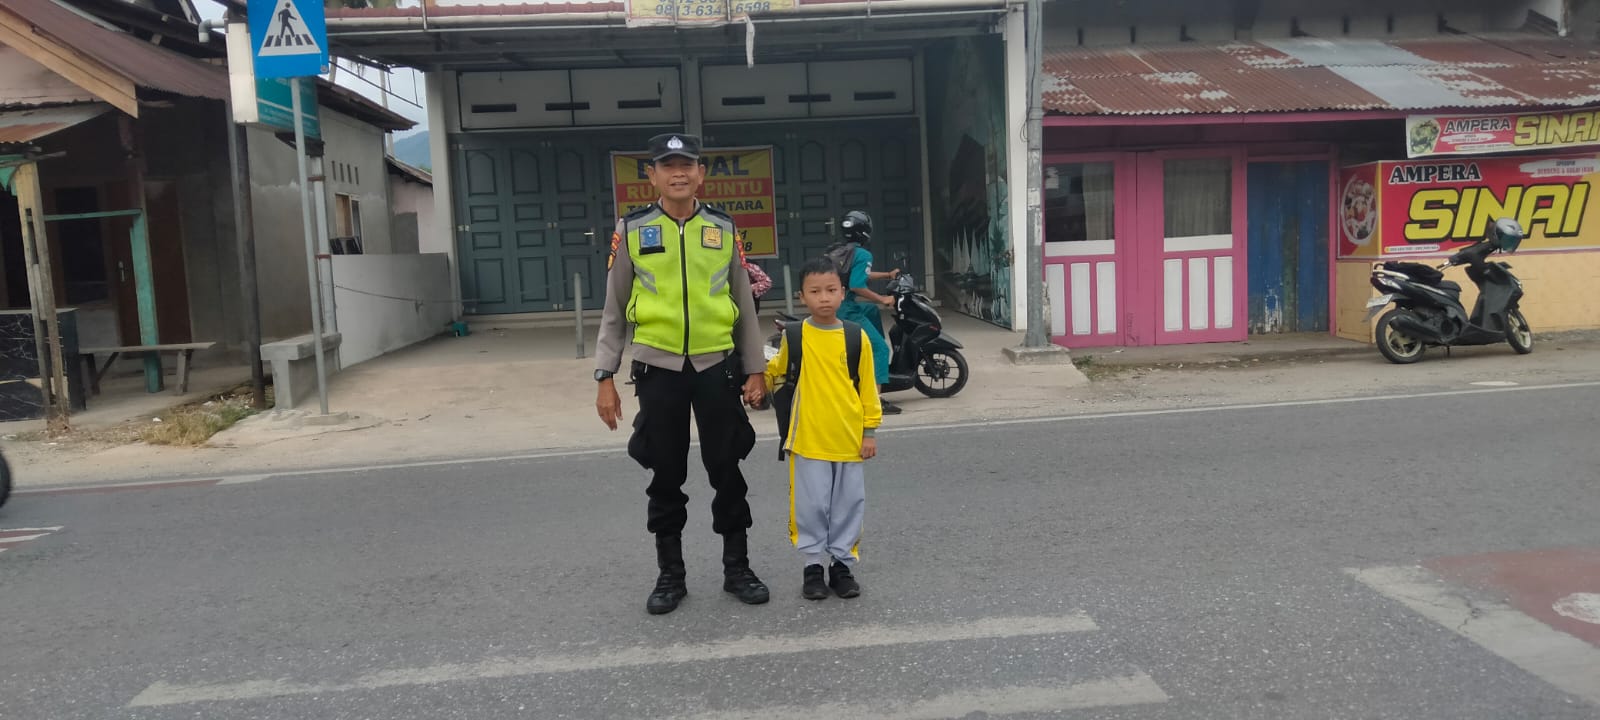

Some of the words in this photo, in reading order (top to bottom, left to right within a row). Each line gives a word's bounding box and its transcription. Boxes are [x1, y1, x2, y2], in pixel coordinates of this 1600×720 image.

[656, 2, 770, 15] 0813-634-6598
[1445, 118, 1512, 133] AMPERA
[1390, 164, 1481, 184] AMPERA
[705, 181, 763, 195] PINTU
[1404, 182, 1590, 242] SINAI
